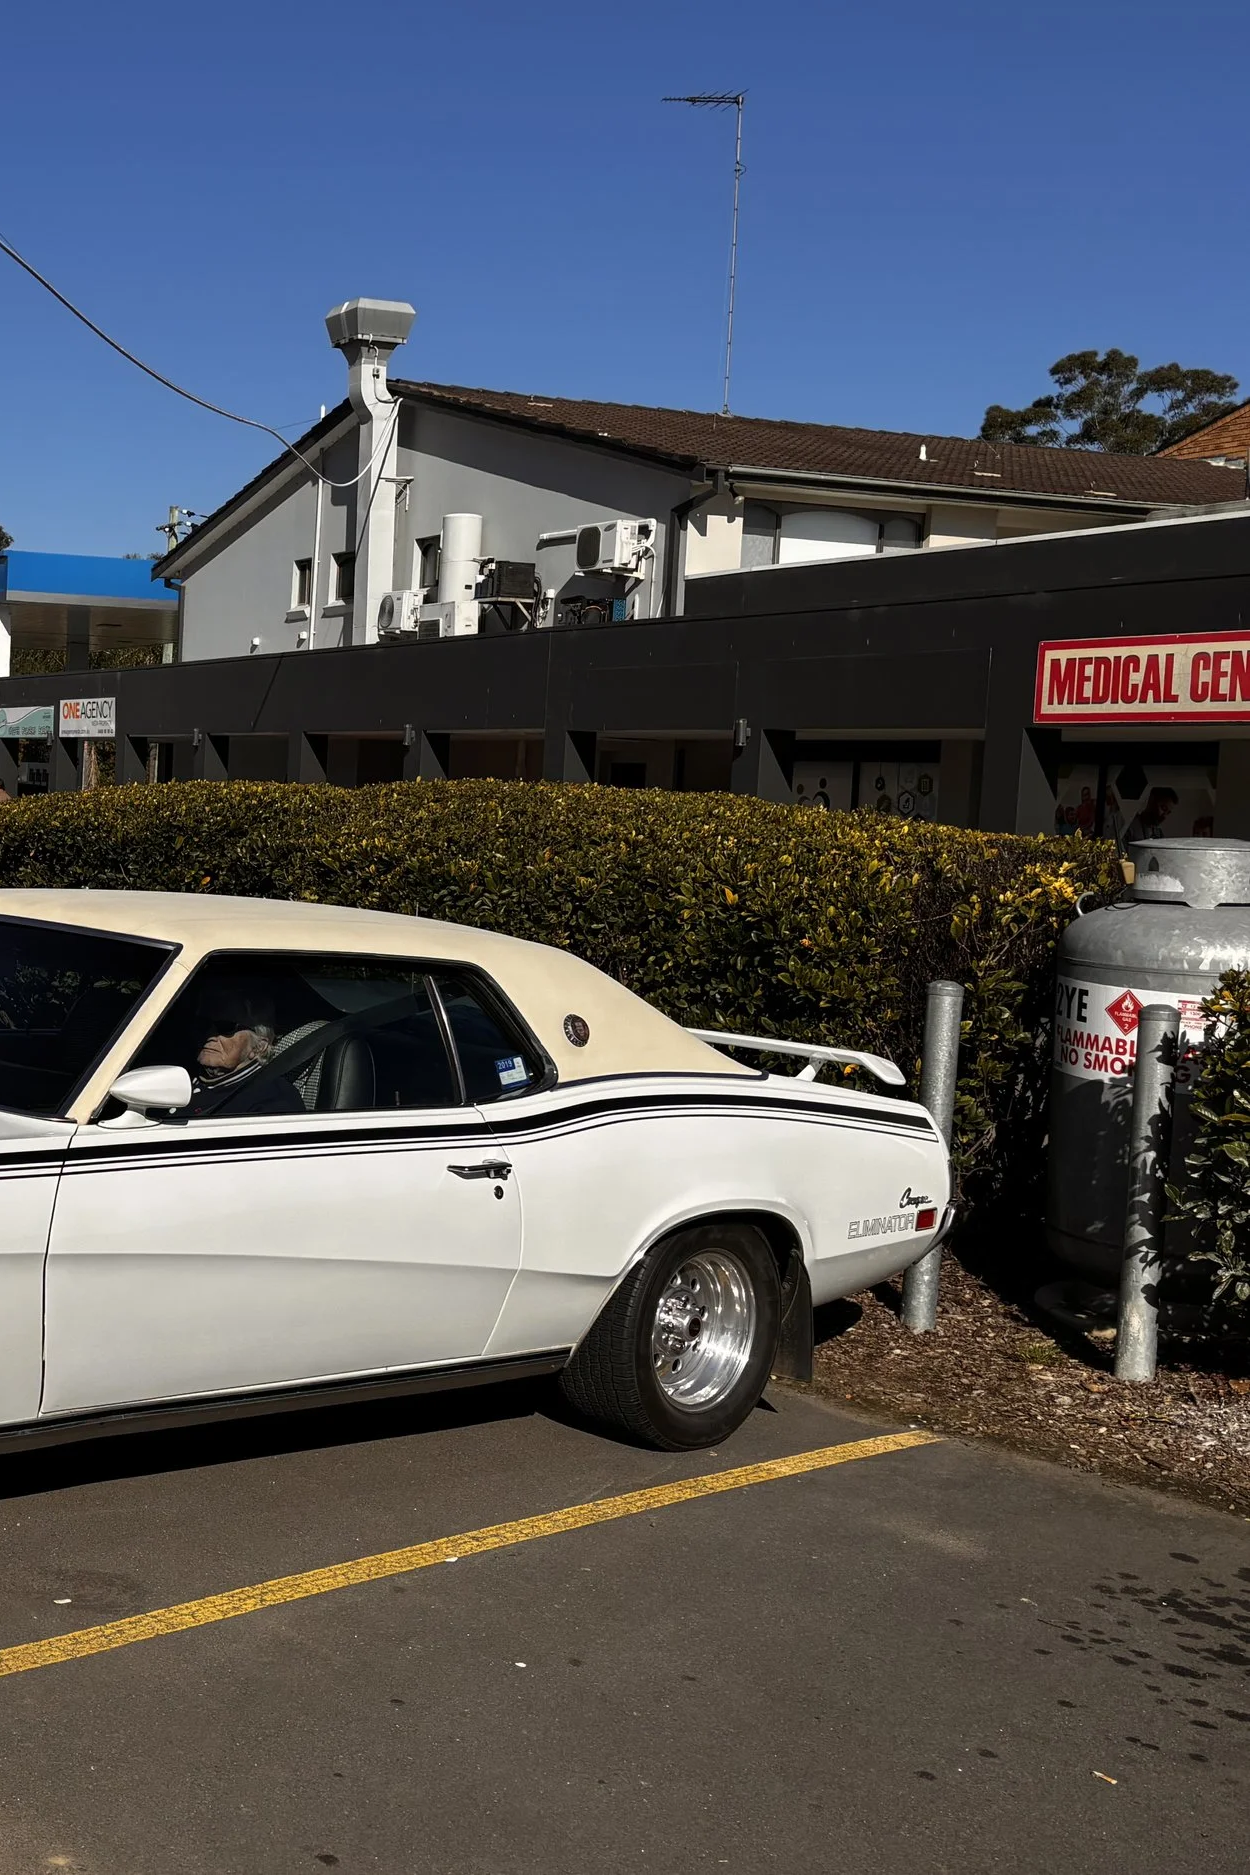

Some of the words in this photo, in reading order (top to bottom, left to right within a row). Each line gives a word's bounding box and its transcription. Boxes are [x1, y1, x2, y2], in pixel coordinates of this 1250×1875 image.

[1047, 653, 1179, 706] MEDICAL
[1114, 1011, 1139, 1019] FLAMMABL
[1057, 1024, 1138, 1057] FLAMMABL
[497, 1059, 513, 1070] 2019
[1061, 1045, 1079, 1066] NO
[847, 1212, 915, 1240] ELIMINATOR
